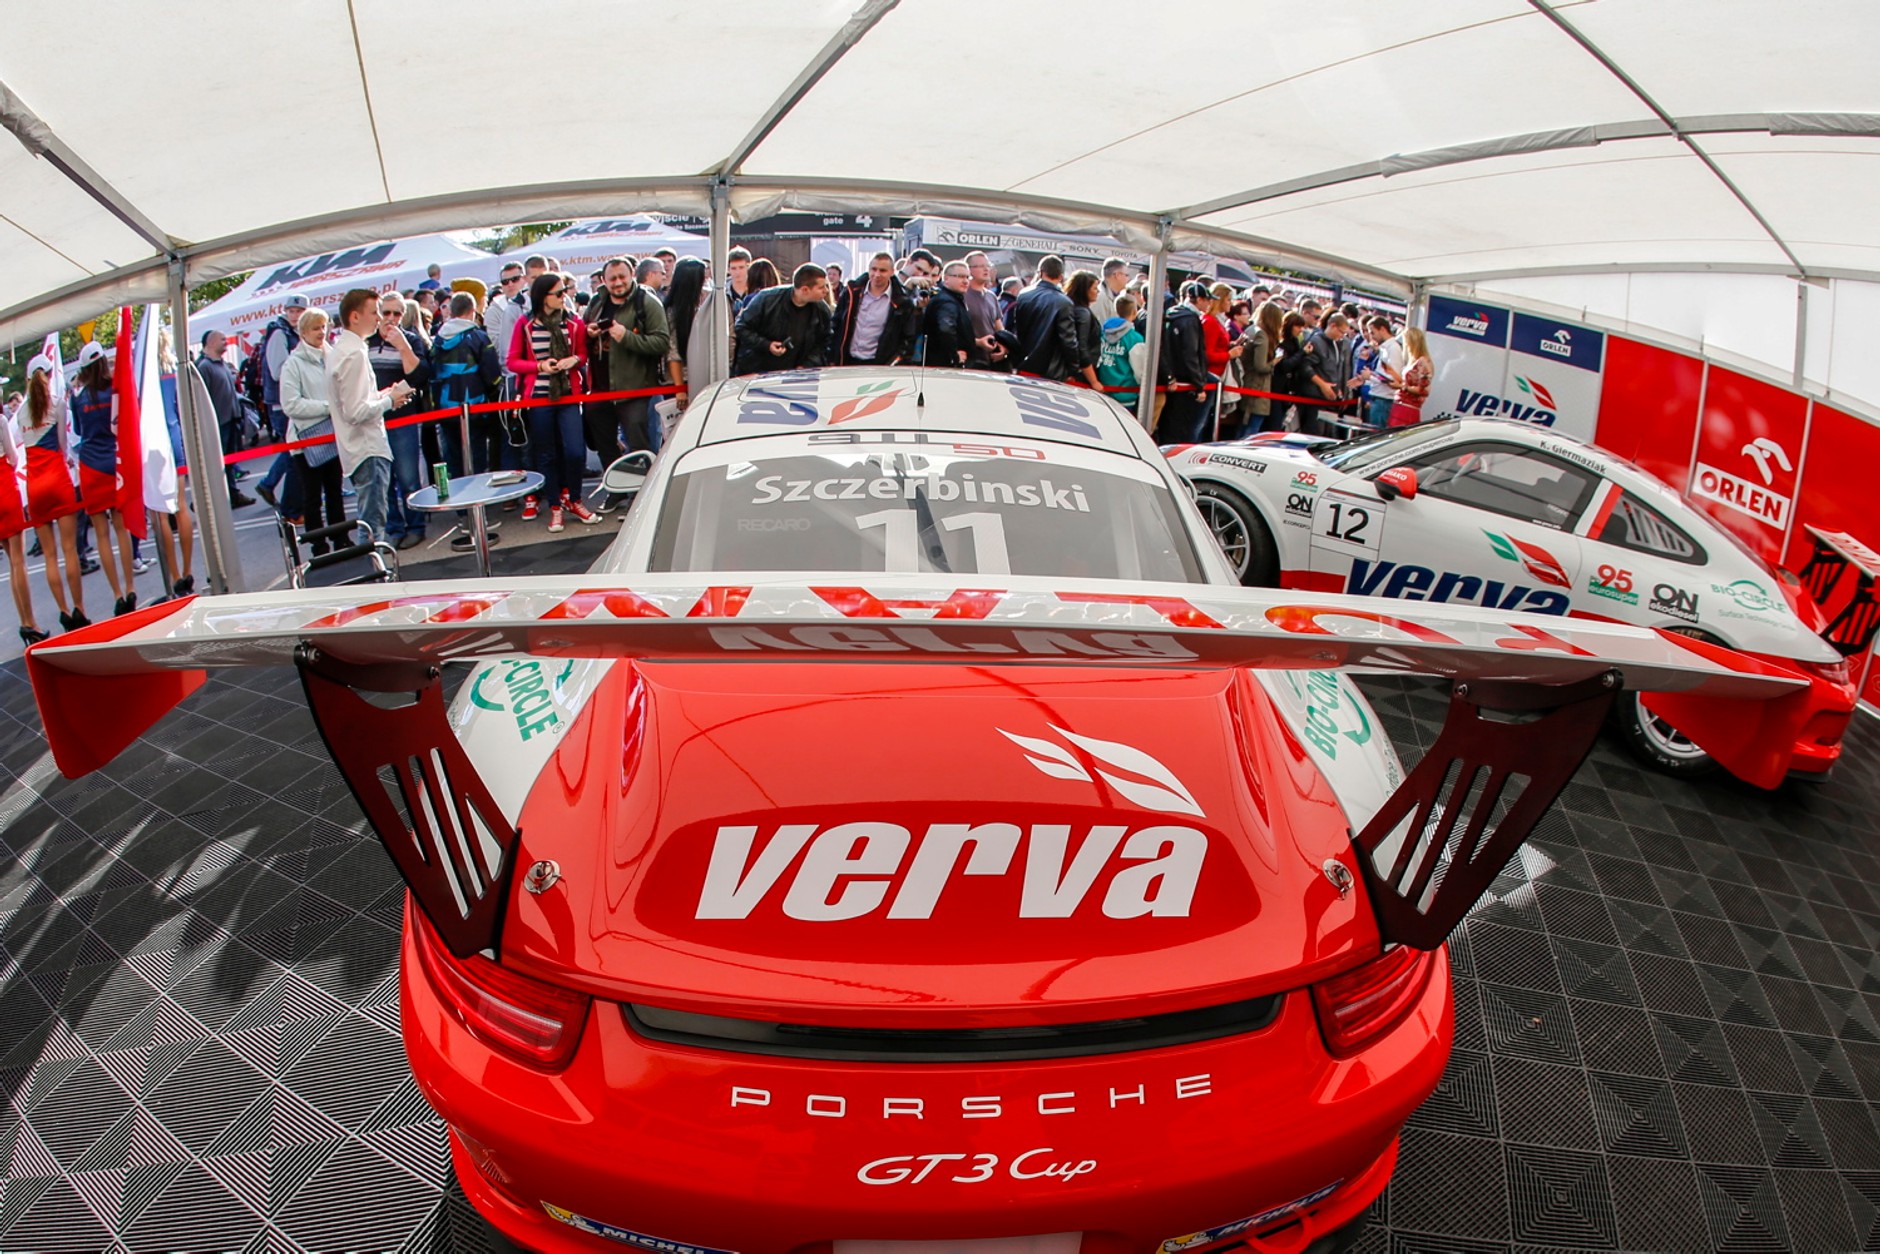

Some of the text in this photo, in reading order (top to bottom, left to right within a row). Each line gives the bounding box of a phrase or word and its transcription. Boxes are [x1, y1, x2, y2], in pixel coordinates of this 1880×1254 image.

[823, 217, 844, 226] gate
[855, 215, 873, 228] 4
[959, 233, 1000, 246] ORLEN
[1069, 244, 1100, 254] SONY
[1111, 249, 1138, 259] TOYOTA
[255, 243, 397, 291] KTM
[1453, 315, 1488, 331] verva
[1542, 341, 1569, 354] ORLEN
[1211, 455, 1265, 471] CONVERT
[1540, 440, 1607, 475] K. Giermaziak
[752, 472, 1091, 513] Szczerbinski
[1297, 471, 1318, 486] 95
[1287, 493, 1313, 513] ON
[1700, 469, 1783, 527] ORLEN
[737, 518, 812, 532] RECARO
[1326, 503, 1369, 545] 12
[855, 508, 1011, 575] 11
[1346, 557, 1571, 617] verva
[1597, 564, 1633, 593] 95
[1649, 602, 1698, 622] ekodiesel
[1653, 583, 1699, 613] ON
[1710, 583, 1787, 613] BIO-CIRCLE
[694, 821, 1209, 922] verva
[731, 1073, 1212, 1119] PORSCHE
[1009, 1147, 1097, 1182] Cup
